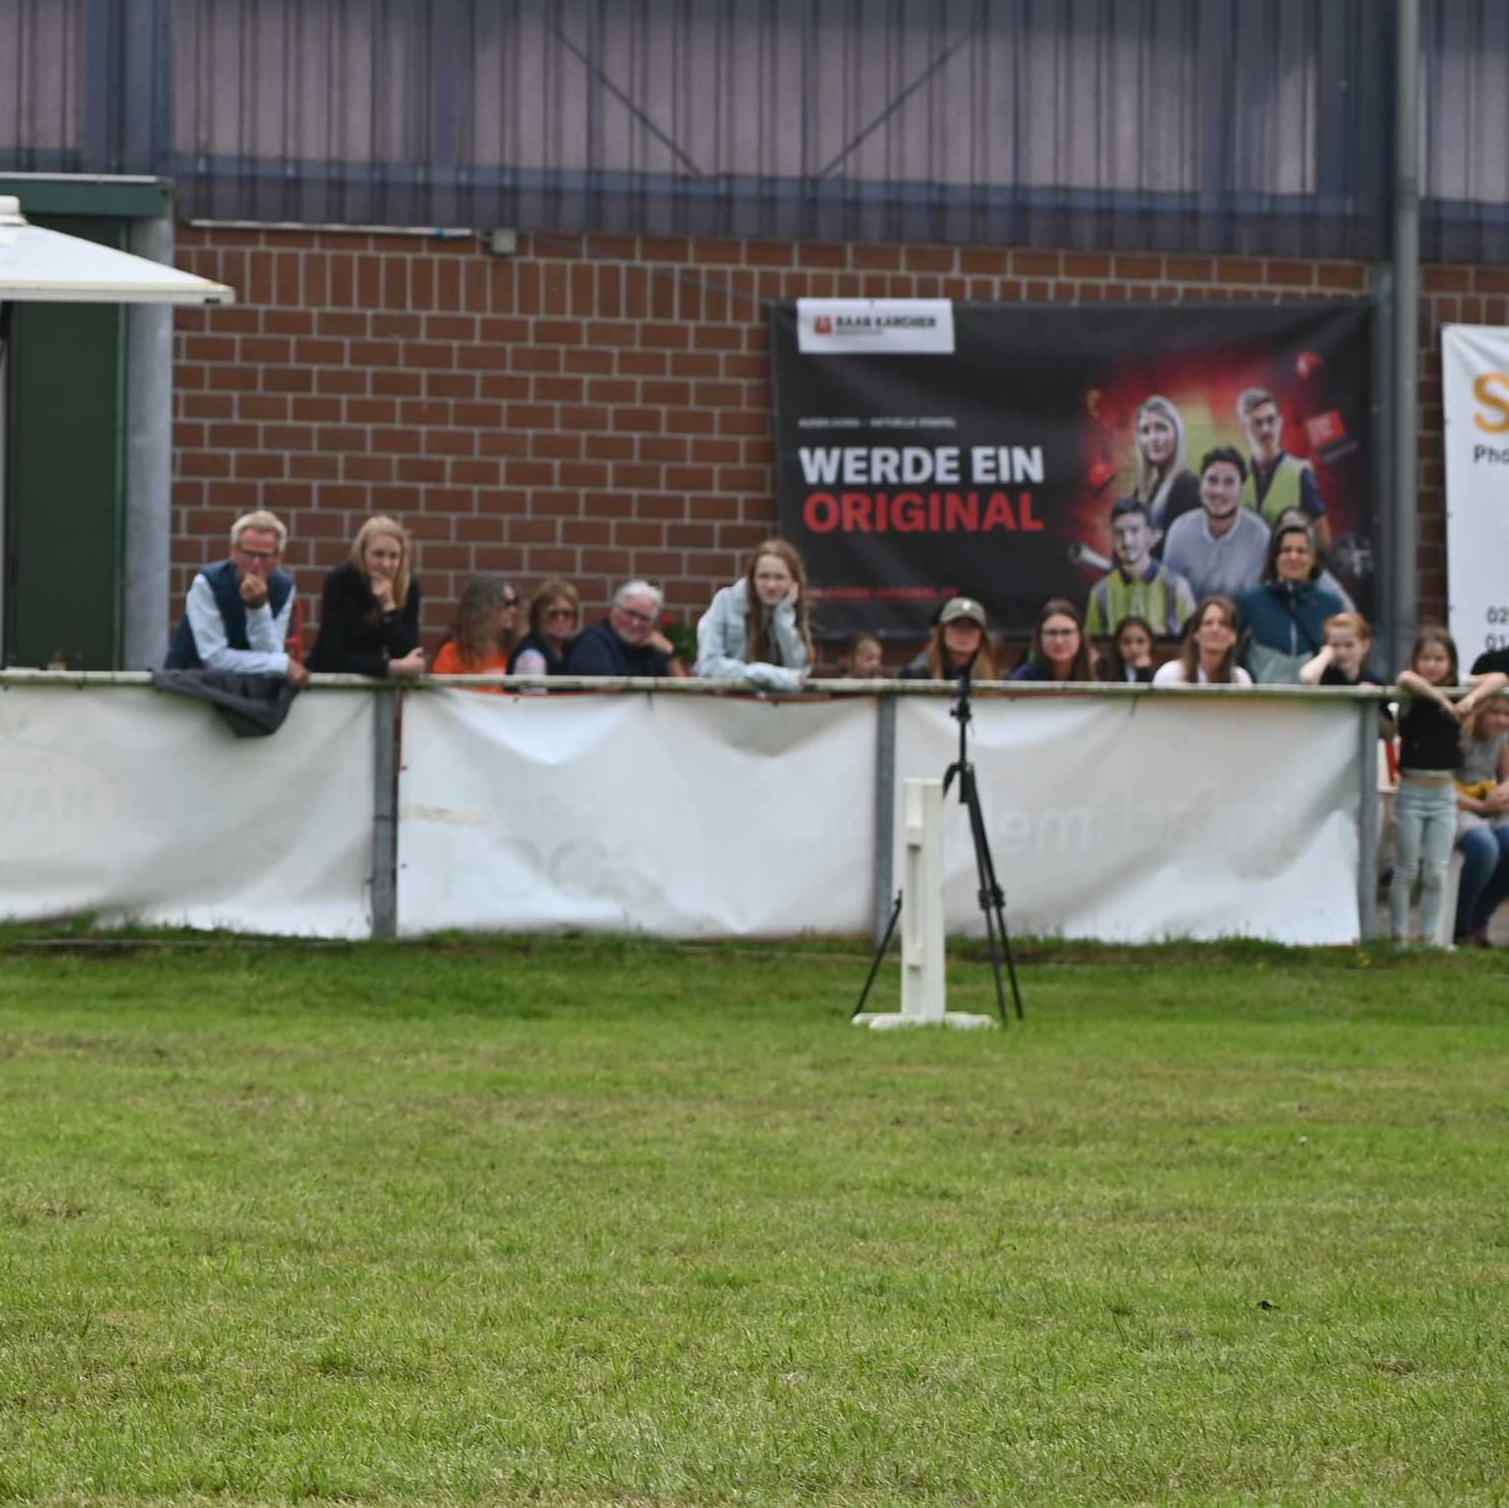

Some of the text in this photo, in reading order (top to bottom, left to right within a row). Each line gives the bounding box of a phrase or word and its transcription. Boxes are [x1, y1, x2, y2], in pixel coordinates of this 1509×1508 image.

[798, 446, 1045, 485] WERDE EIN
[803, 492, 1045, 533] ORIGINAL
